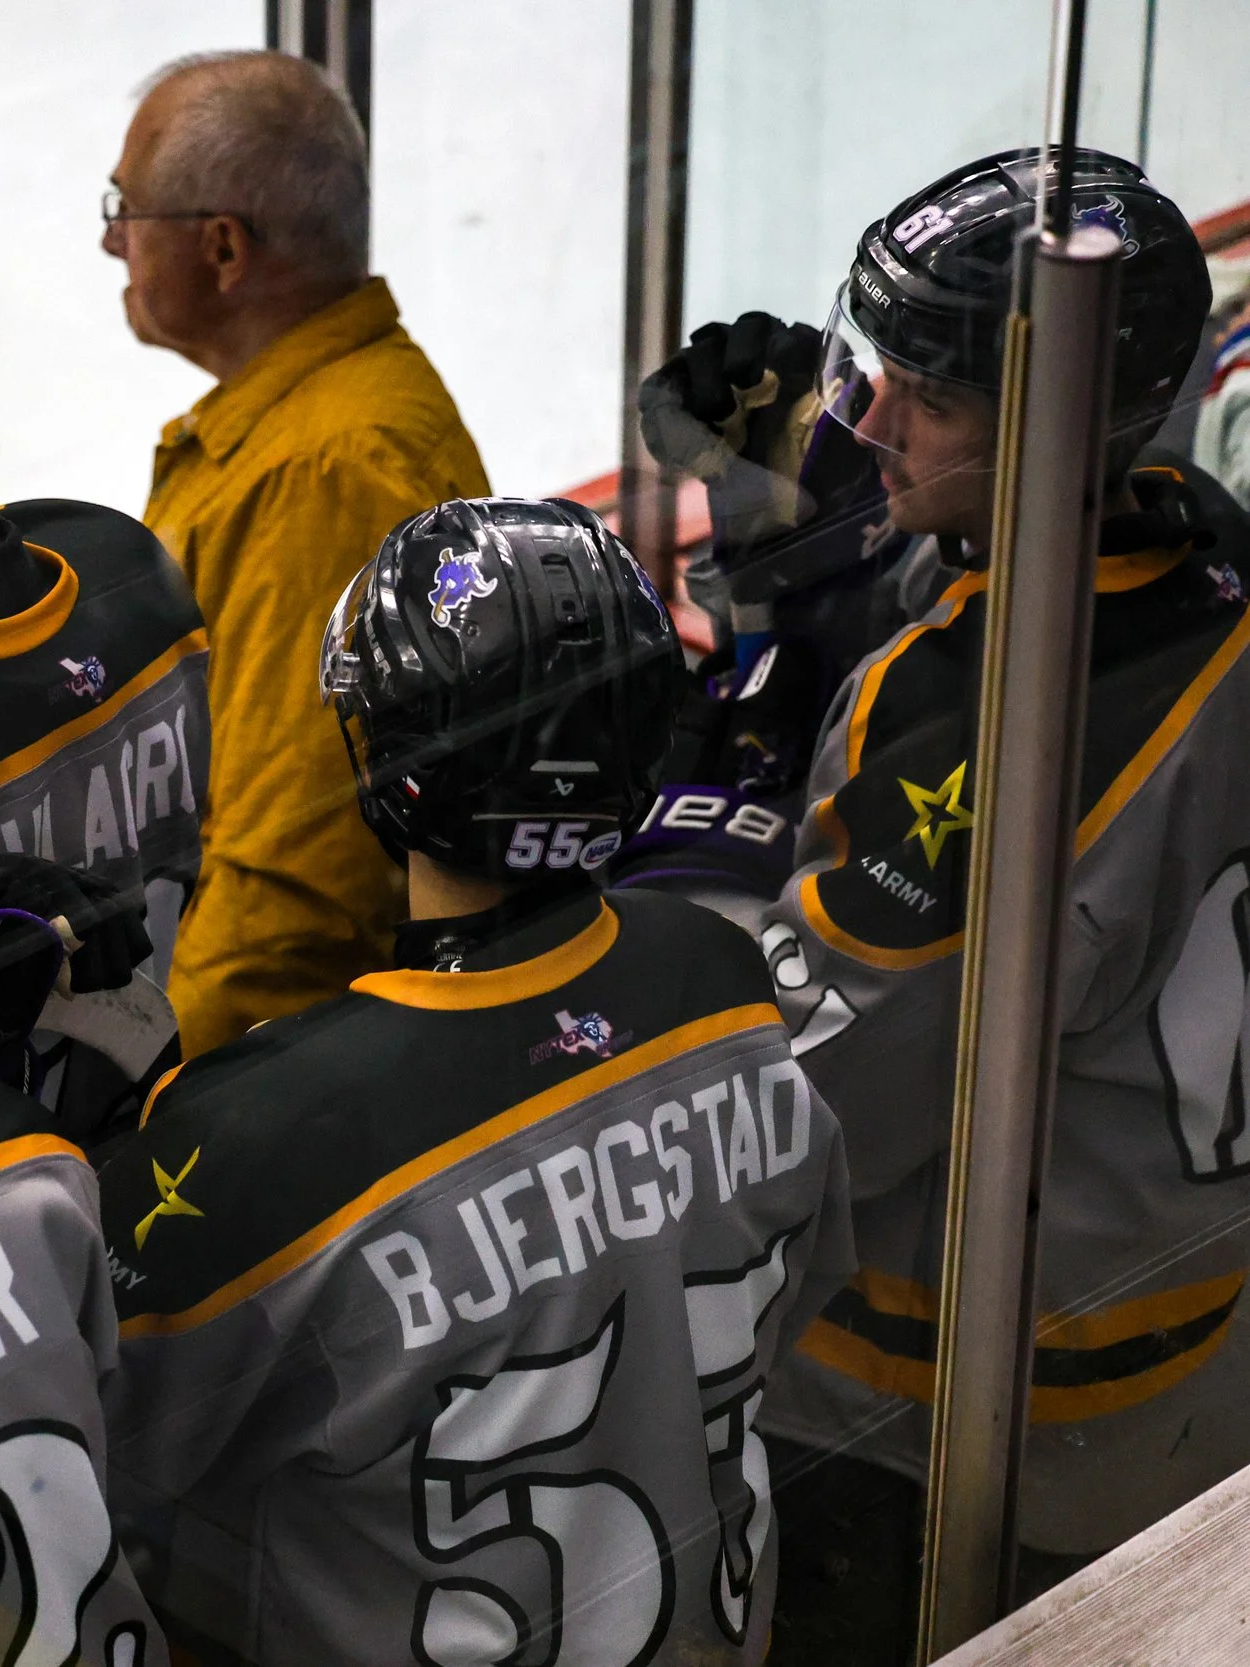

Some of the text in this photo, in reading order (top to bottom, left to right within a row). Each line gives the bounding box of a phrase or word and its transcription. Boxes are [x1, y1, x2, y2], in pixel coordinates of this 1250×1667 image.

[892, 205, 954, 254] 61
[505, 821, 590, 869] 55
[868, 861, 938, 913] ARMY
[360, 1058, 812, 1350] BJERGSTAD
[106, 1246, 148, 1290] MY
